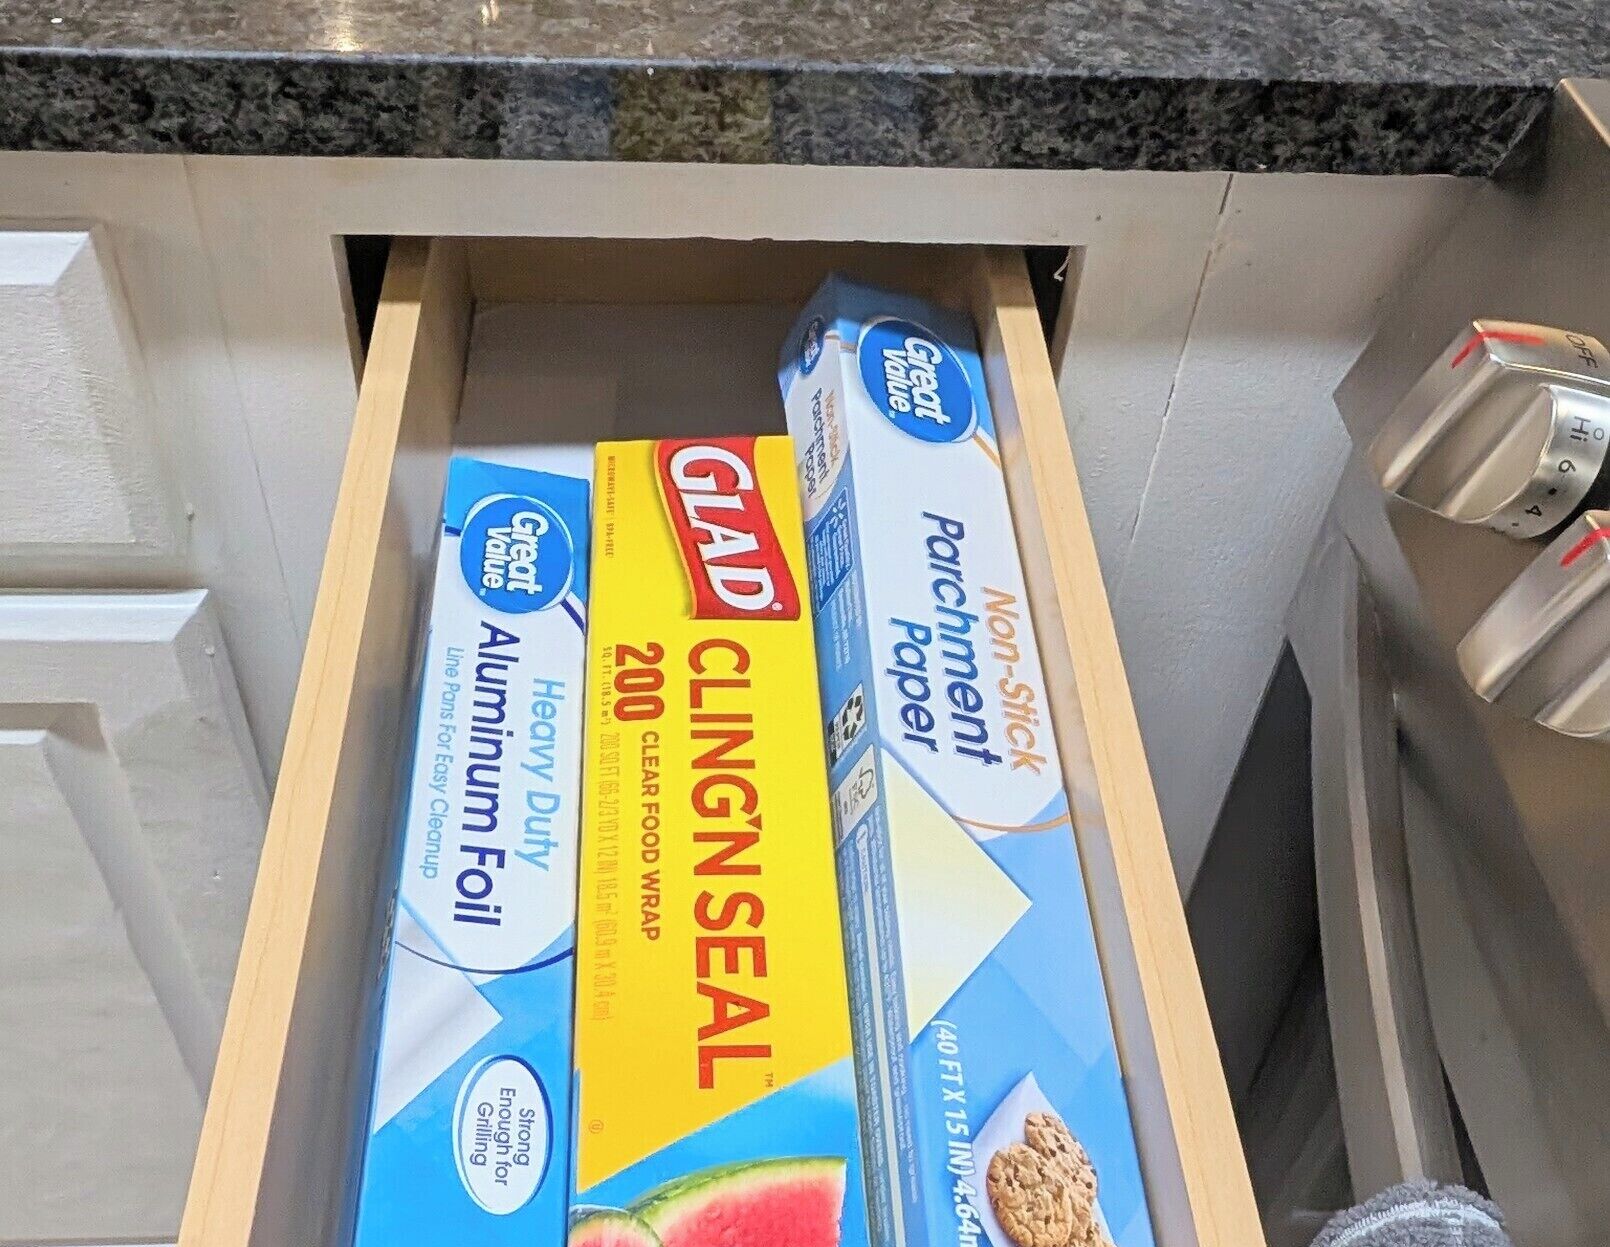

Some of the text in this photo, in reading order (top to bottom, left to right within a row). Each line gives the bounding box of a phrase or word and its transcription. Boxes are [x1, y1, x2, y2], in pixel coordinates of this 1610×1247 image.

[883, 348, 912, 414] Value
[905, 337, 951, 426] Great
[1566, 333, 1598, 369] OFF
[1570, 416, 1592, 442] Hi
[483, 527, 513, 589] Value
[507, 511, 549, 595] Great
[670, 445, 776, 611] GLAD
[921, 511, 1003, 766] Parchment
[884, 617, 938, 753] Paper
[980, 586, 1047, 775] Non-Stick
[419, 646, 465, 881] Line Pans For Easy Cleanup
[453, 620, 521, 926] Aluminum Foil
[514, 678, 566, 872] Heavy Duty
[614, 642, 665, 941] 200 CLEAR FOOD WRAP
[931, 1019, 958, 1056] (40
[938, 1059, 964, 1087] FT
[941, 1087, 967, 1105] X
[944, 1108, 970, 1137] 15
[469, 1101, 494, 1167] Grilling
[493, 1087, 516, 1186] Enough for
[513, 1107, 536, 1167] Strong
[946, 1140, 976, 1178] IN)
